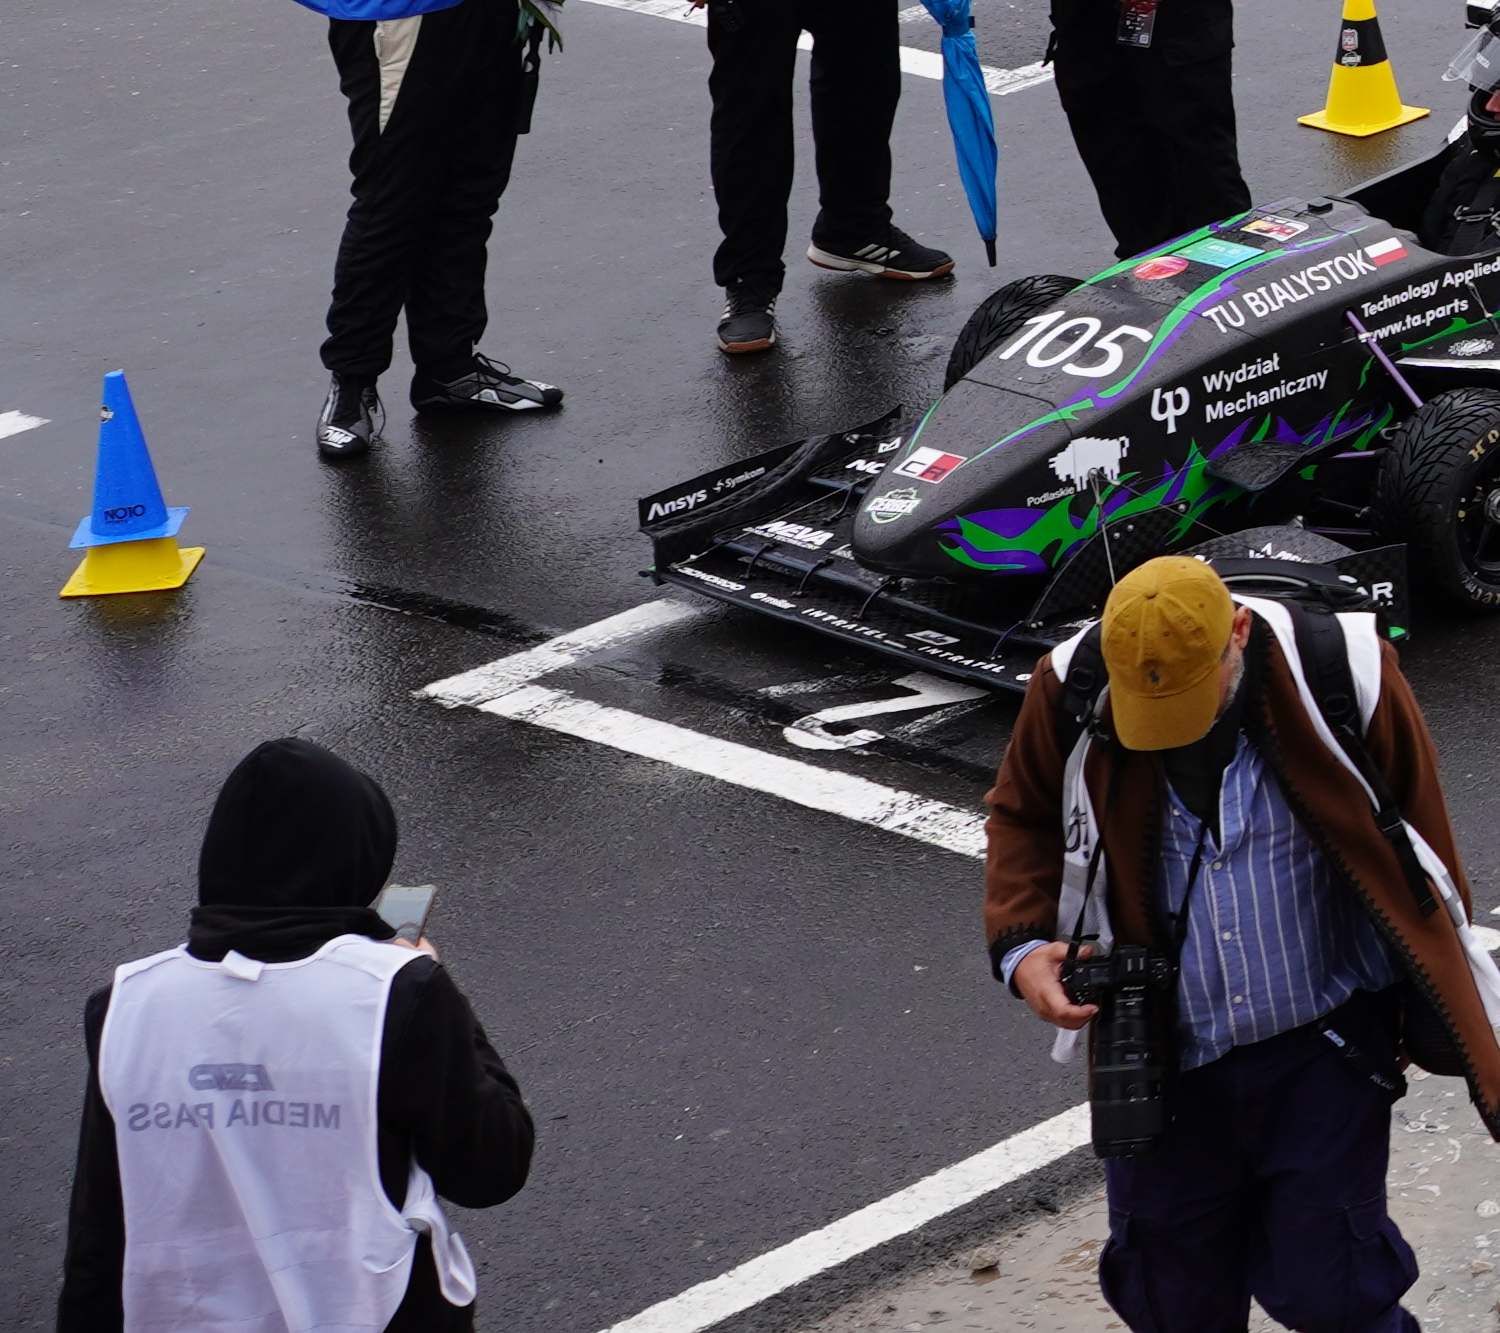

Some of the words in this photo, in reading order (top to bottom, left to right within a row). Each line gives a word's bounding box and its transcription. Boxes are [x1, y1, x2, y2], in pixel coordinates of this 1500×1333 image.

[1202, 301, 1246, 333] TU
[1243, 249, 1378, 320] BIALYSTOK
[1361, 277, 1439, 318] Technology
[1000, 310, 1153, 378] 105
[1203, 352, 1280, 395] Wydział
[1204, 369, 1329, 425] Mechaniczny
[321, 429, 353, 445] OMP
[724, 465, 766, 489] Symkom
[647, 489, 708, 522] Ansys
[1026, 486, 1076, 509] Podlaskie
[757, 521, 835, 546] NEVA
[801, 608, 888, 640] INTRATEL
[918, 645, 1006, 674] INTRATEL
